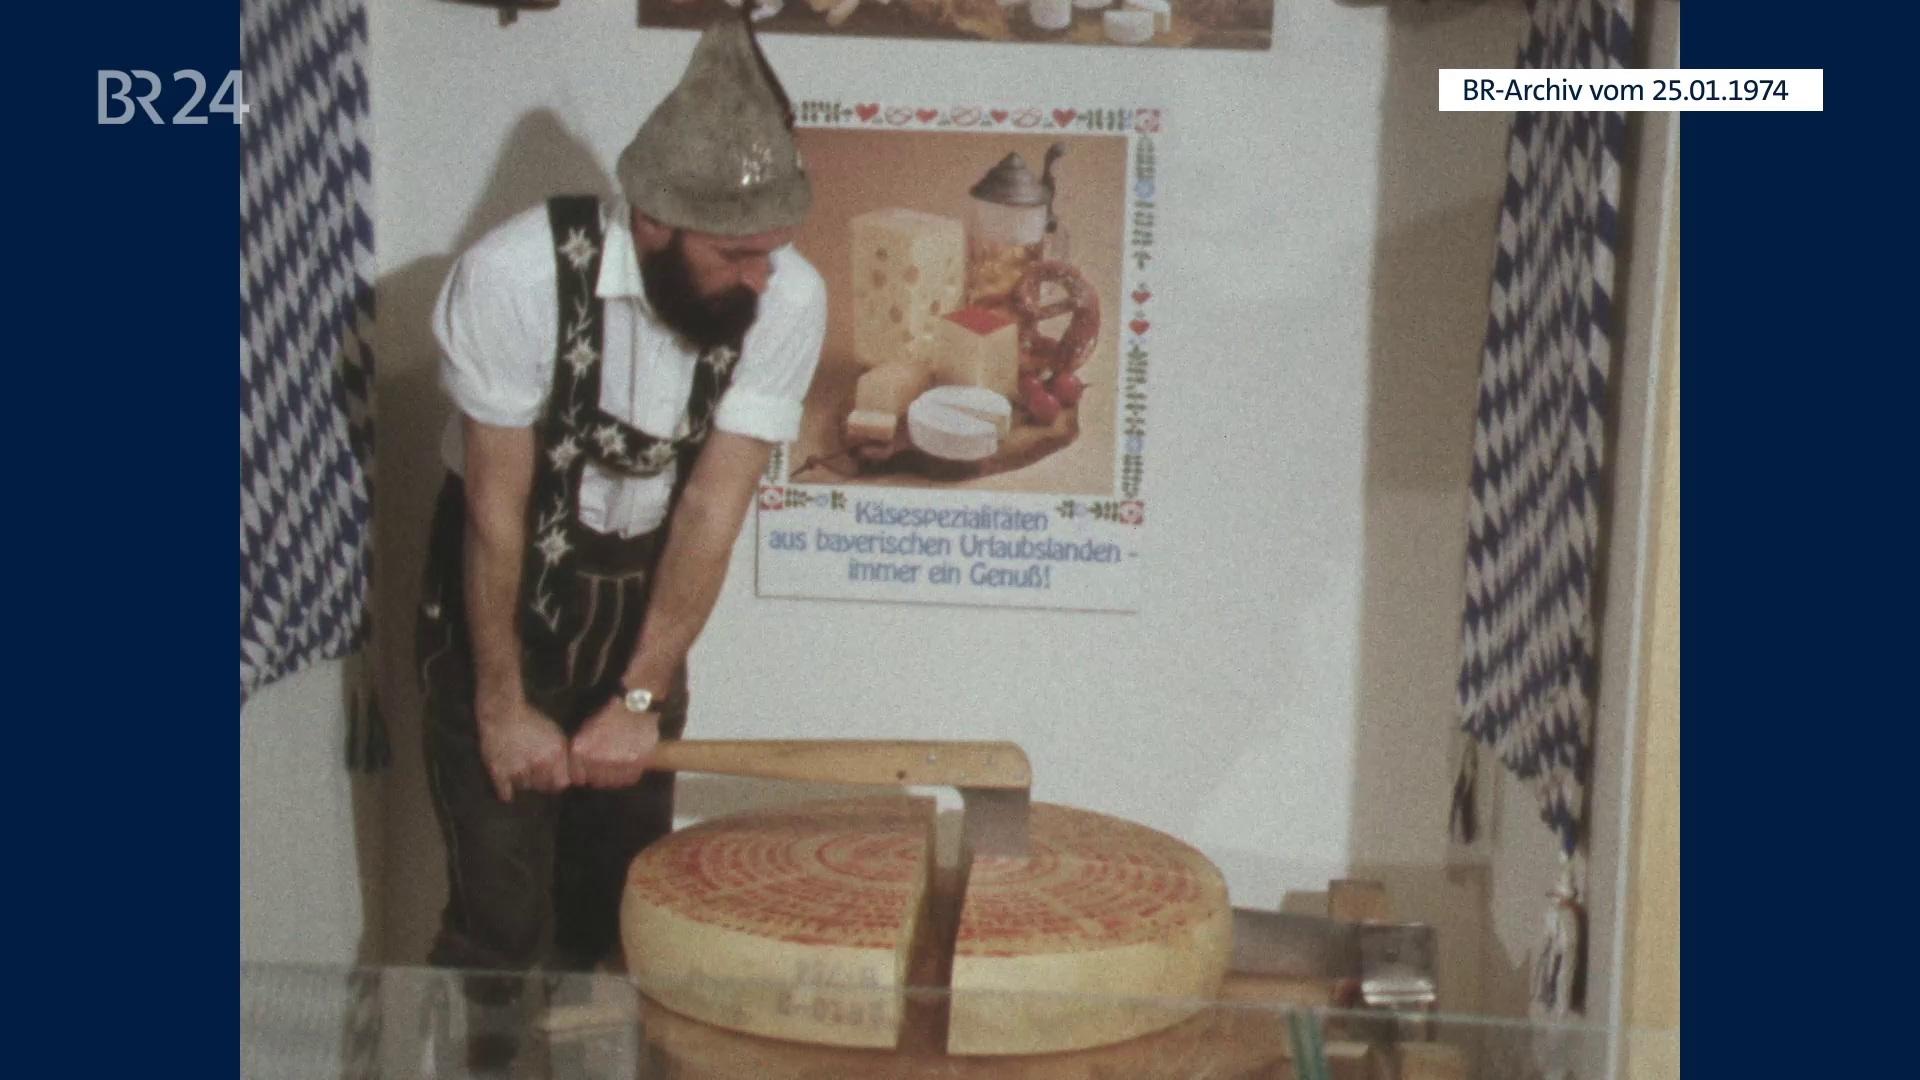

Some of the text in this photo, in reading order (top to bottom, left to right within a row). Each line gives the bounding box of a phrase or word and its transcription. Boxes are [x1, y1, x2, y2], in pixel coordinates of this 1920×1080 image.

[855, 500, 1049, 532] Käsespezialitäten
[768, 529, 806, 551] aus
[815, 529, 951, 557] bayerischen
[848, 558, 1051, 589] immer ein Genuß!
